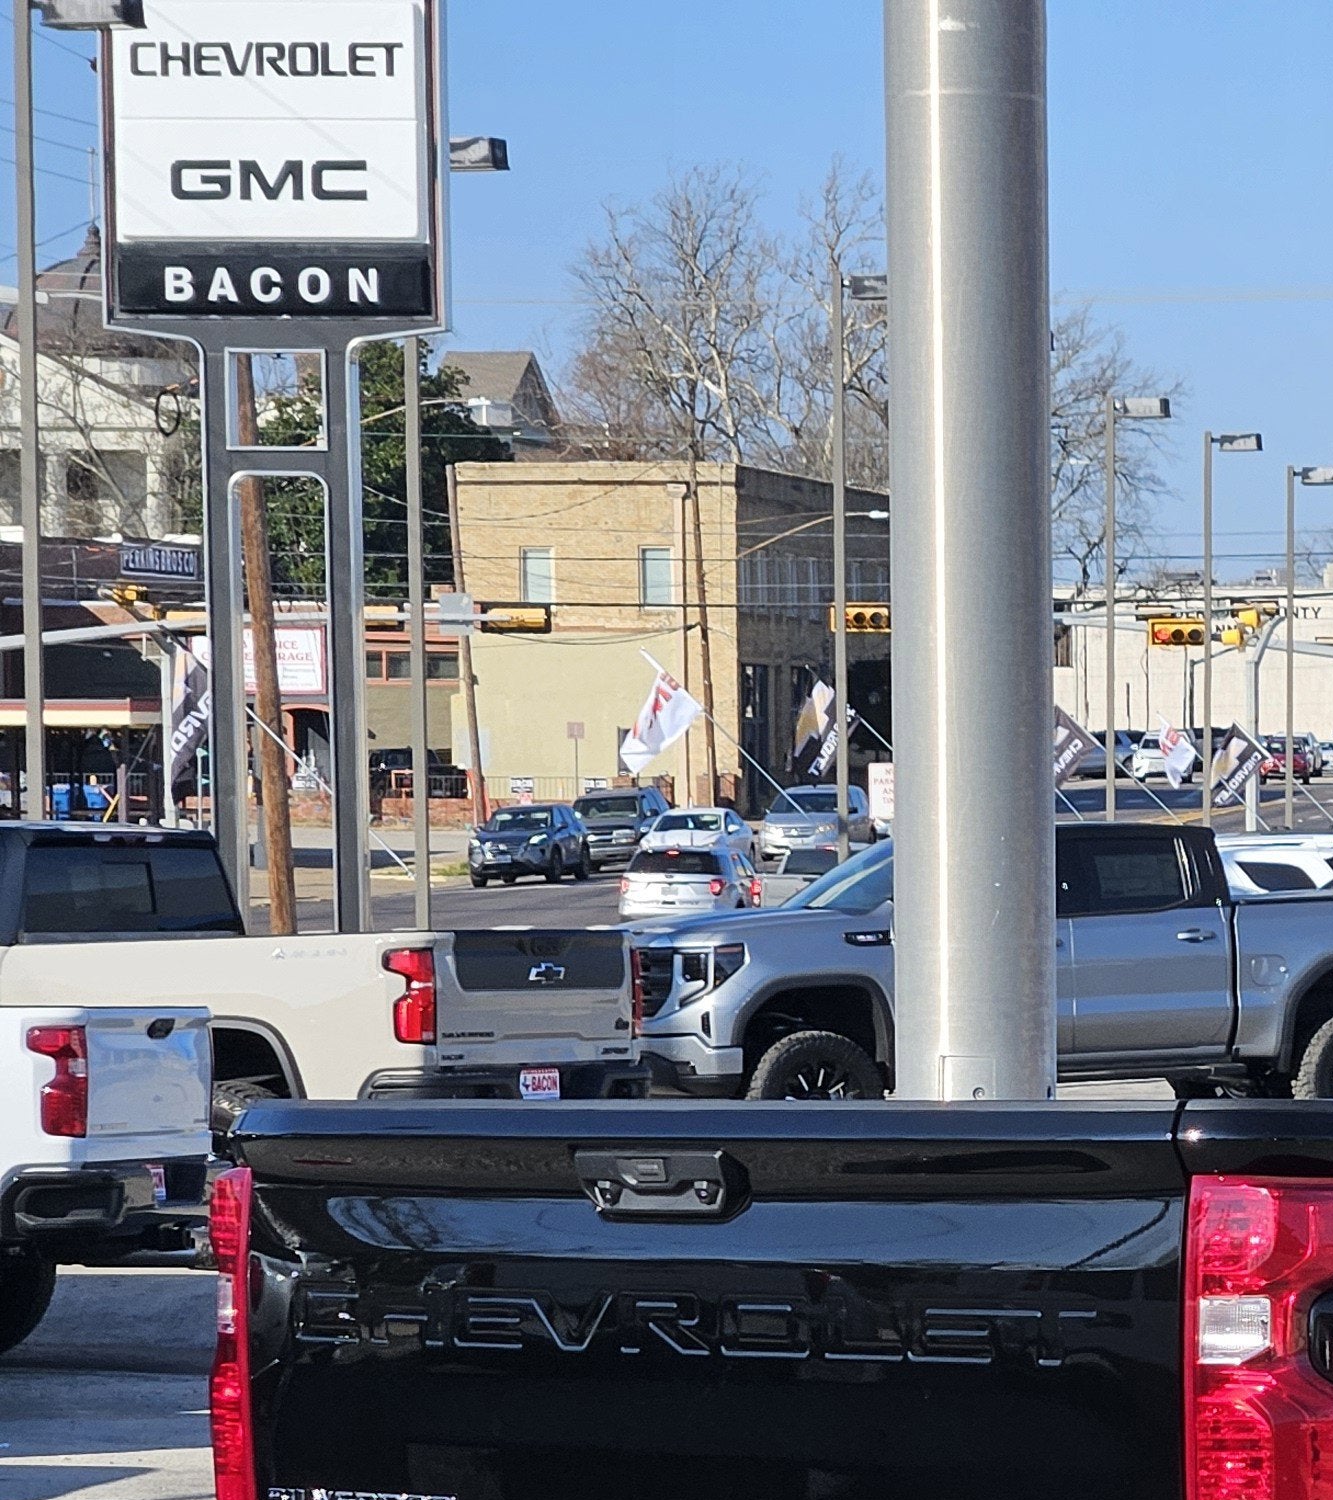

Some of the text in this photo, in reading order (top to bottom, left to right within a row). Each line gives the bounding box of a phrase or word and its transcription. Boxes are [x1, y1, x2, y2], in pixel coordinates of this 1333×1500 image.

[129, 41, 403, 77] CHEVROLET
[170, 159, 367, 201] GMC
[164, 266, 379, 303] BACON
[531, 1075, 558, 1092] BACON
[295, 1289, 1097, 1369] CHEVROLET
